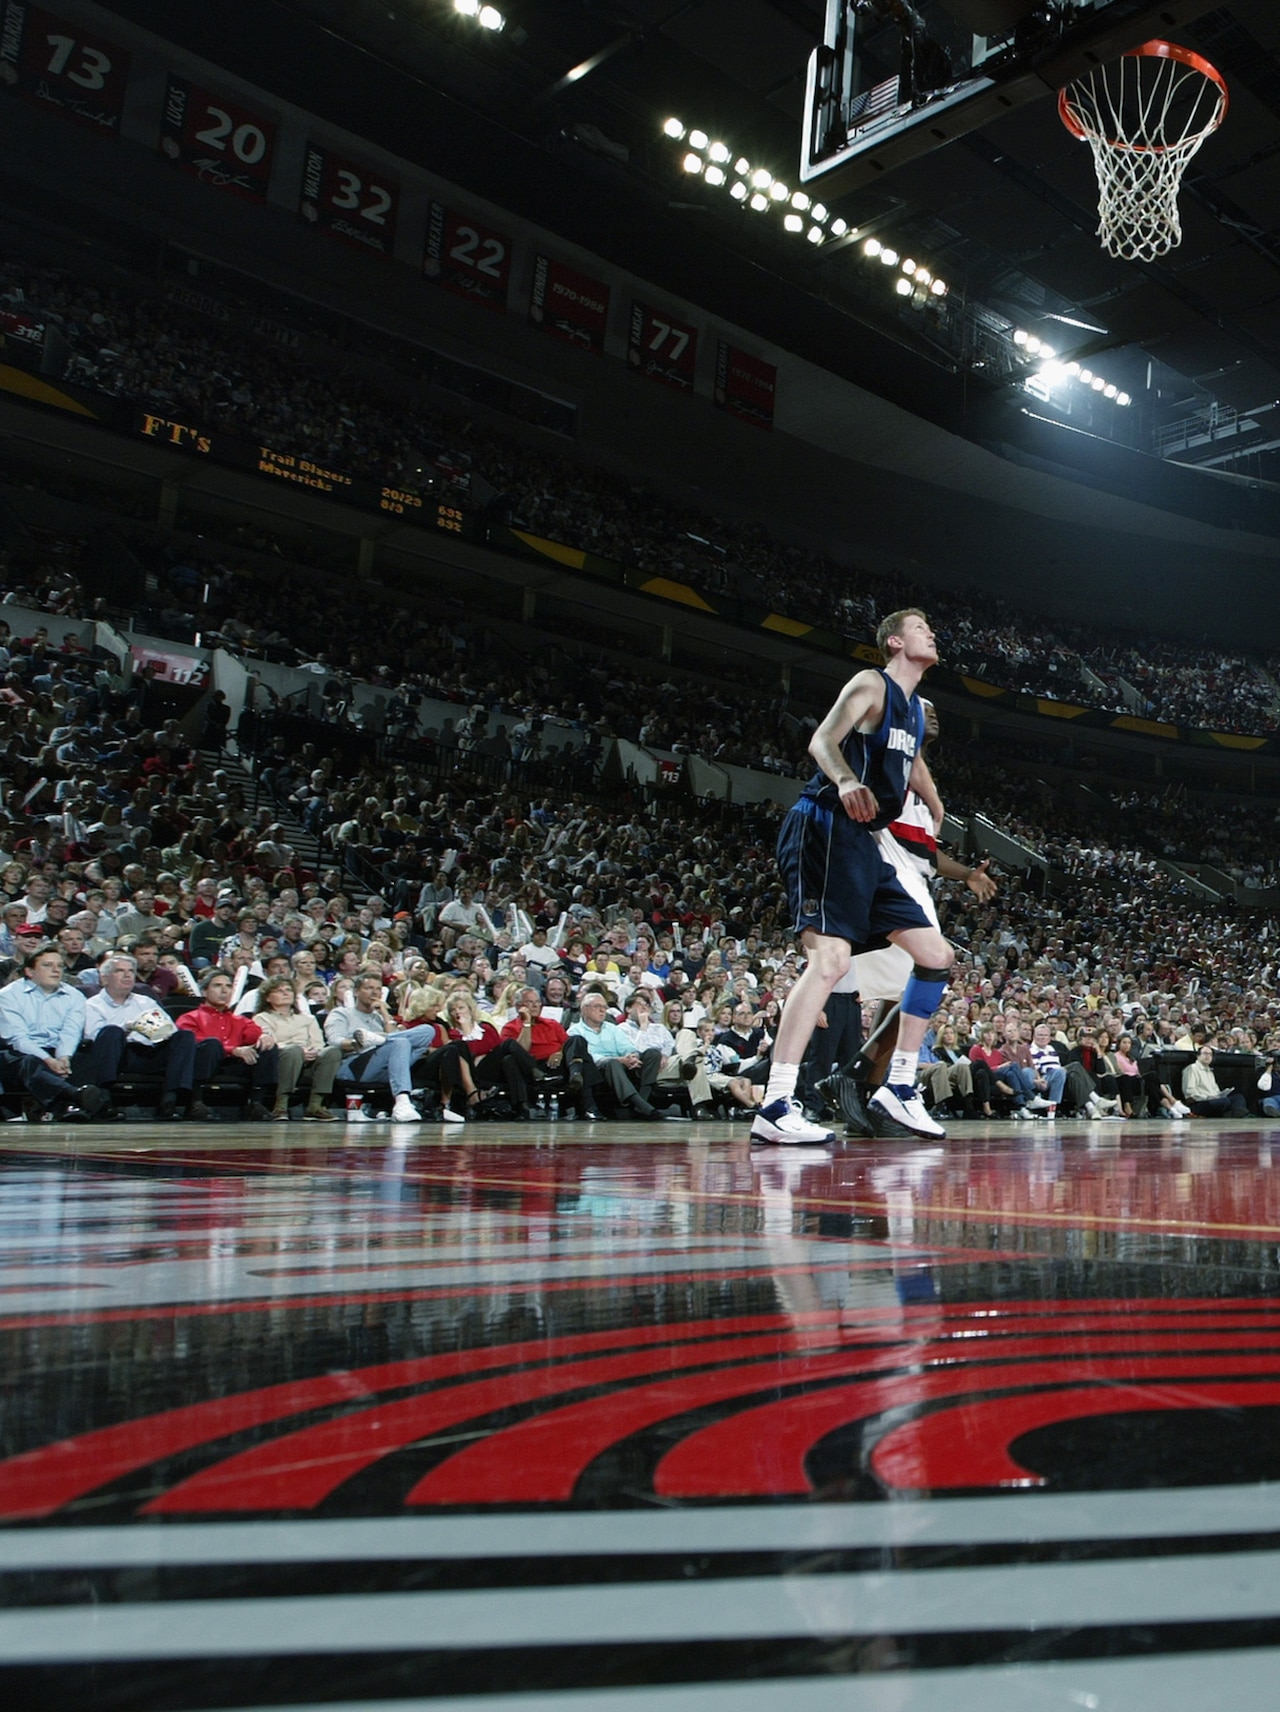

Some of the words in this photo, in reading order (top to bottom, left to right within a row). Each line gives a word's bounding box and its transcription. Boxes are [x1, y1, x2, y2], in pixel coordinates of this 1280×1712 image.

[46, 34, 112, 90] 13
[168, 86, 187, 128] LUCAS
[195, 106, 266, 164] 20
[304, 150, 324, 200] WALTON
[331, 170, 392, 226] 32
[424, 202, 445, 258] DREXLER
[450, 226, 505, 279] 22
[15, 324, 43, 341] 318
[649, 319, 690, 361] 77
[141, 413, 211, 453] FT's
[258, 460, 333, 492] Mavericks
[259, 446, 296, 468] Trail
[299, 459, 352, 486] Blazers
[172, 667, 204, 686] 112
[661, 770, 679, 783] 113
